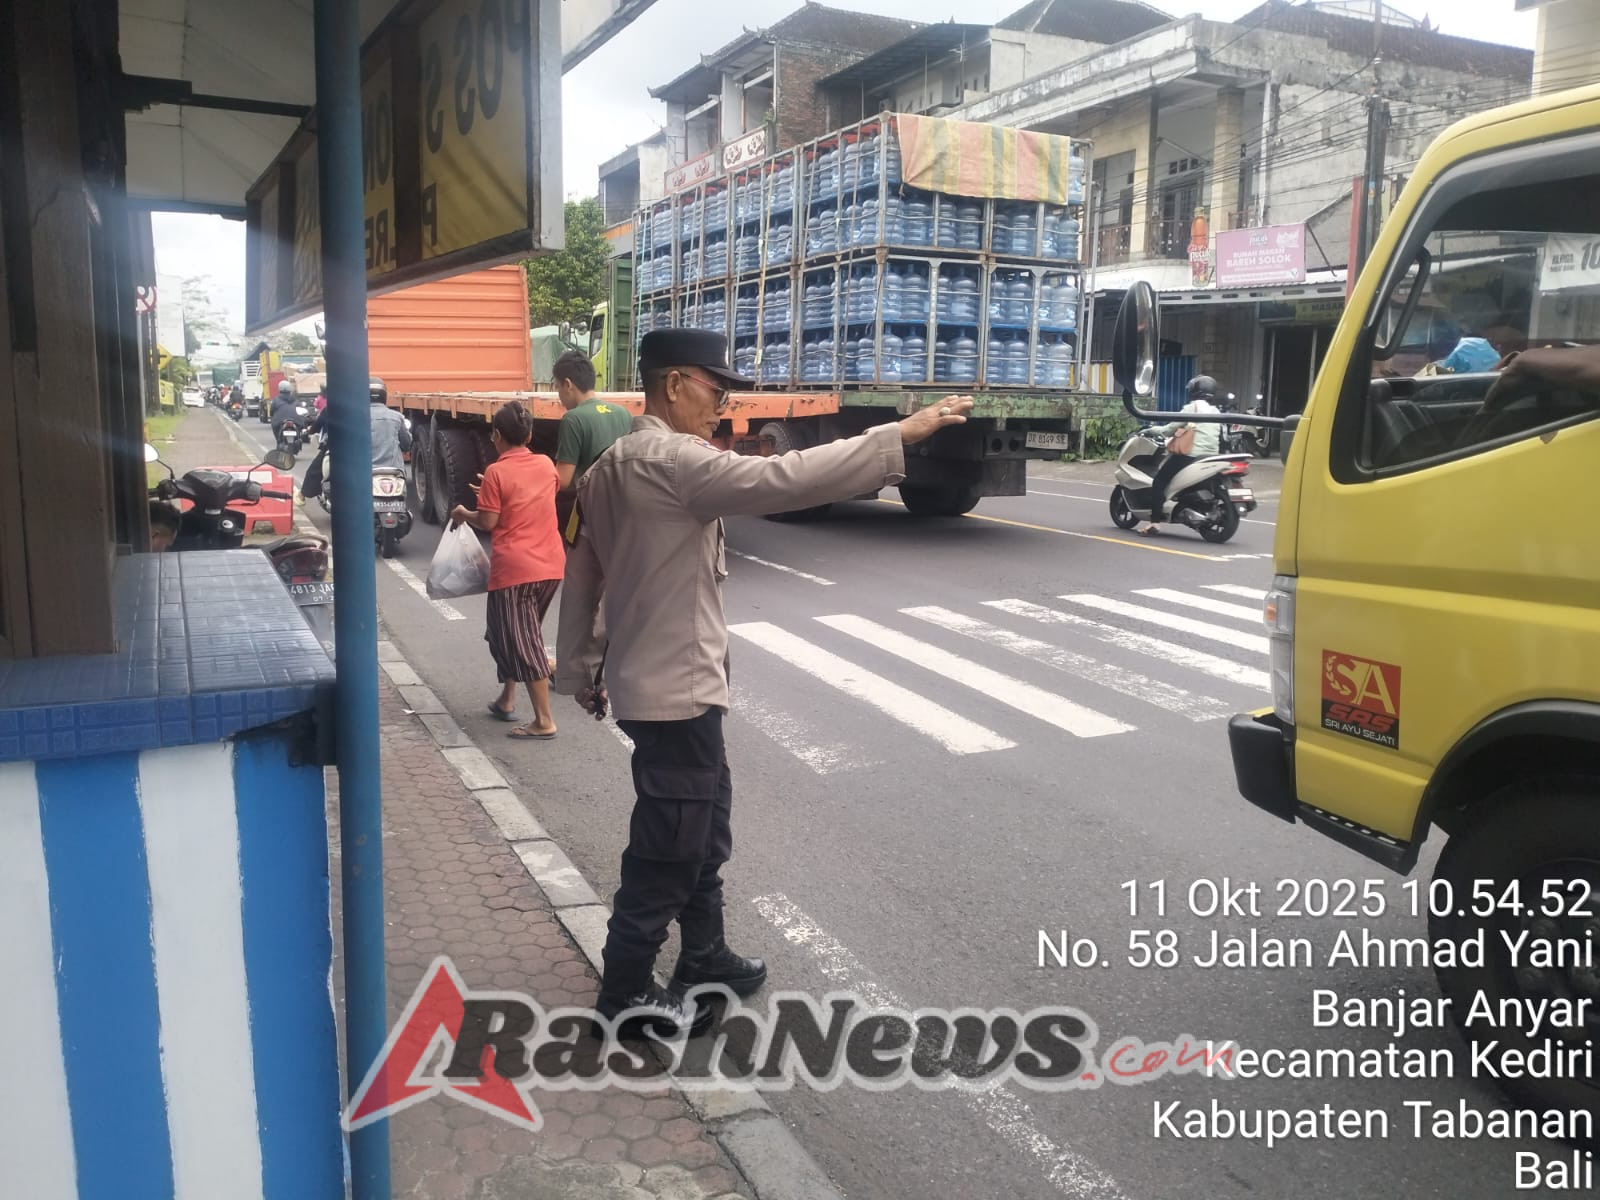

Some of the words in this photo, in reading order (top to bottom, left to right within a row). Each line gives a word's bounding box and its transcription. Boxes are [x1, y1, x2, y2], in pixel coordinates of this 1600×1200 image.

[1226, 257, 1256, 268] BAREH
[1258, 253, 1292, 265] SOLOK
[1324, 718, 1340, 730] SRI
[1341, 723, 1361, 735] AYU
[1363, 729, 1395, 746] SEJATI
